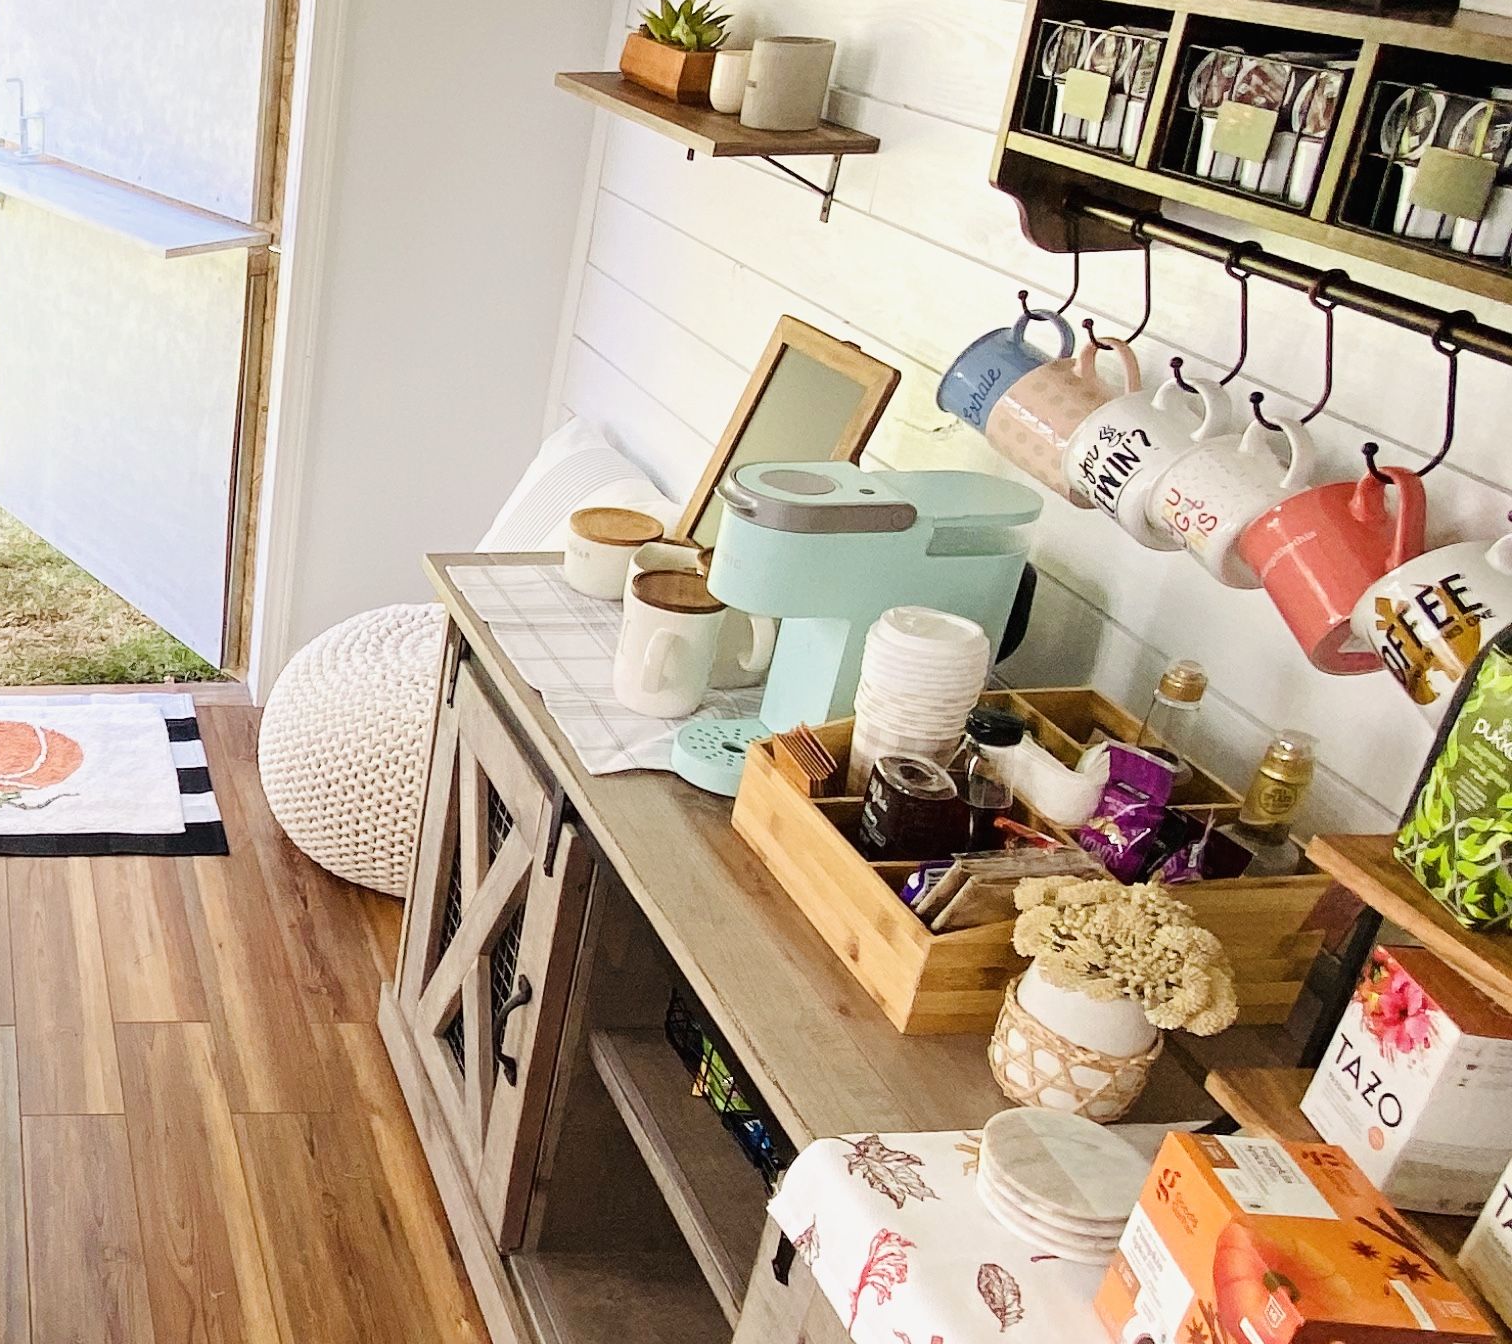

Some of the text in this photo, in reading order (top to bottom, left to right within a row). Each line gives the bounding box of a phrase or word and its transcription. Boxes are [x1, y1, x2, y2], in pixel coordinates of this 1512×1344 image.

[961, 367, 1002, 426] Exhale
[1078, 444, 1100, 485] you
[1335, 1032, 1403, 1128] TAZO
